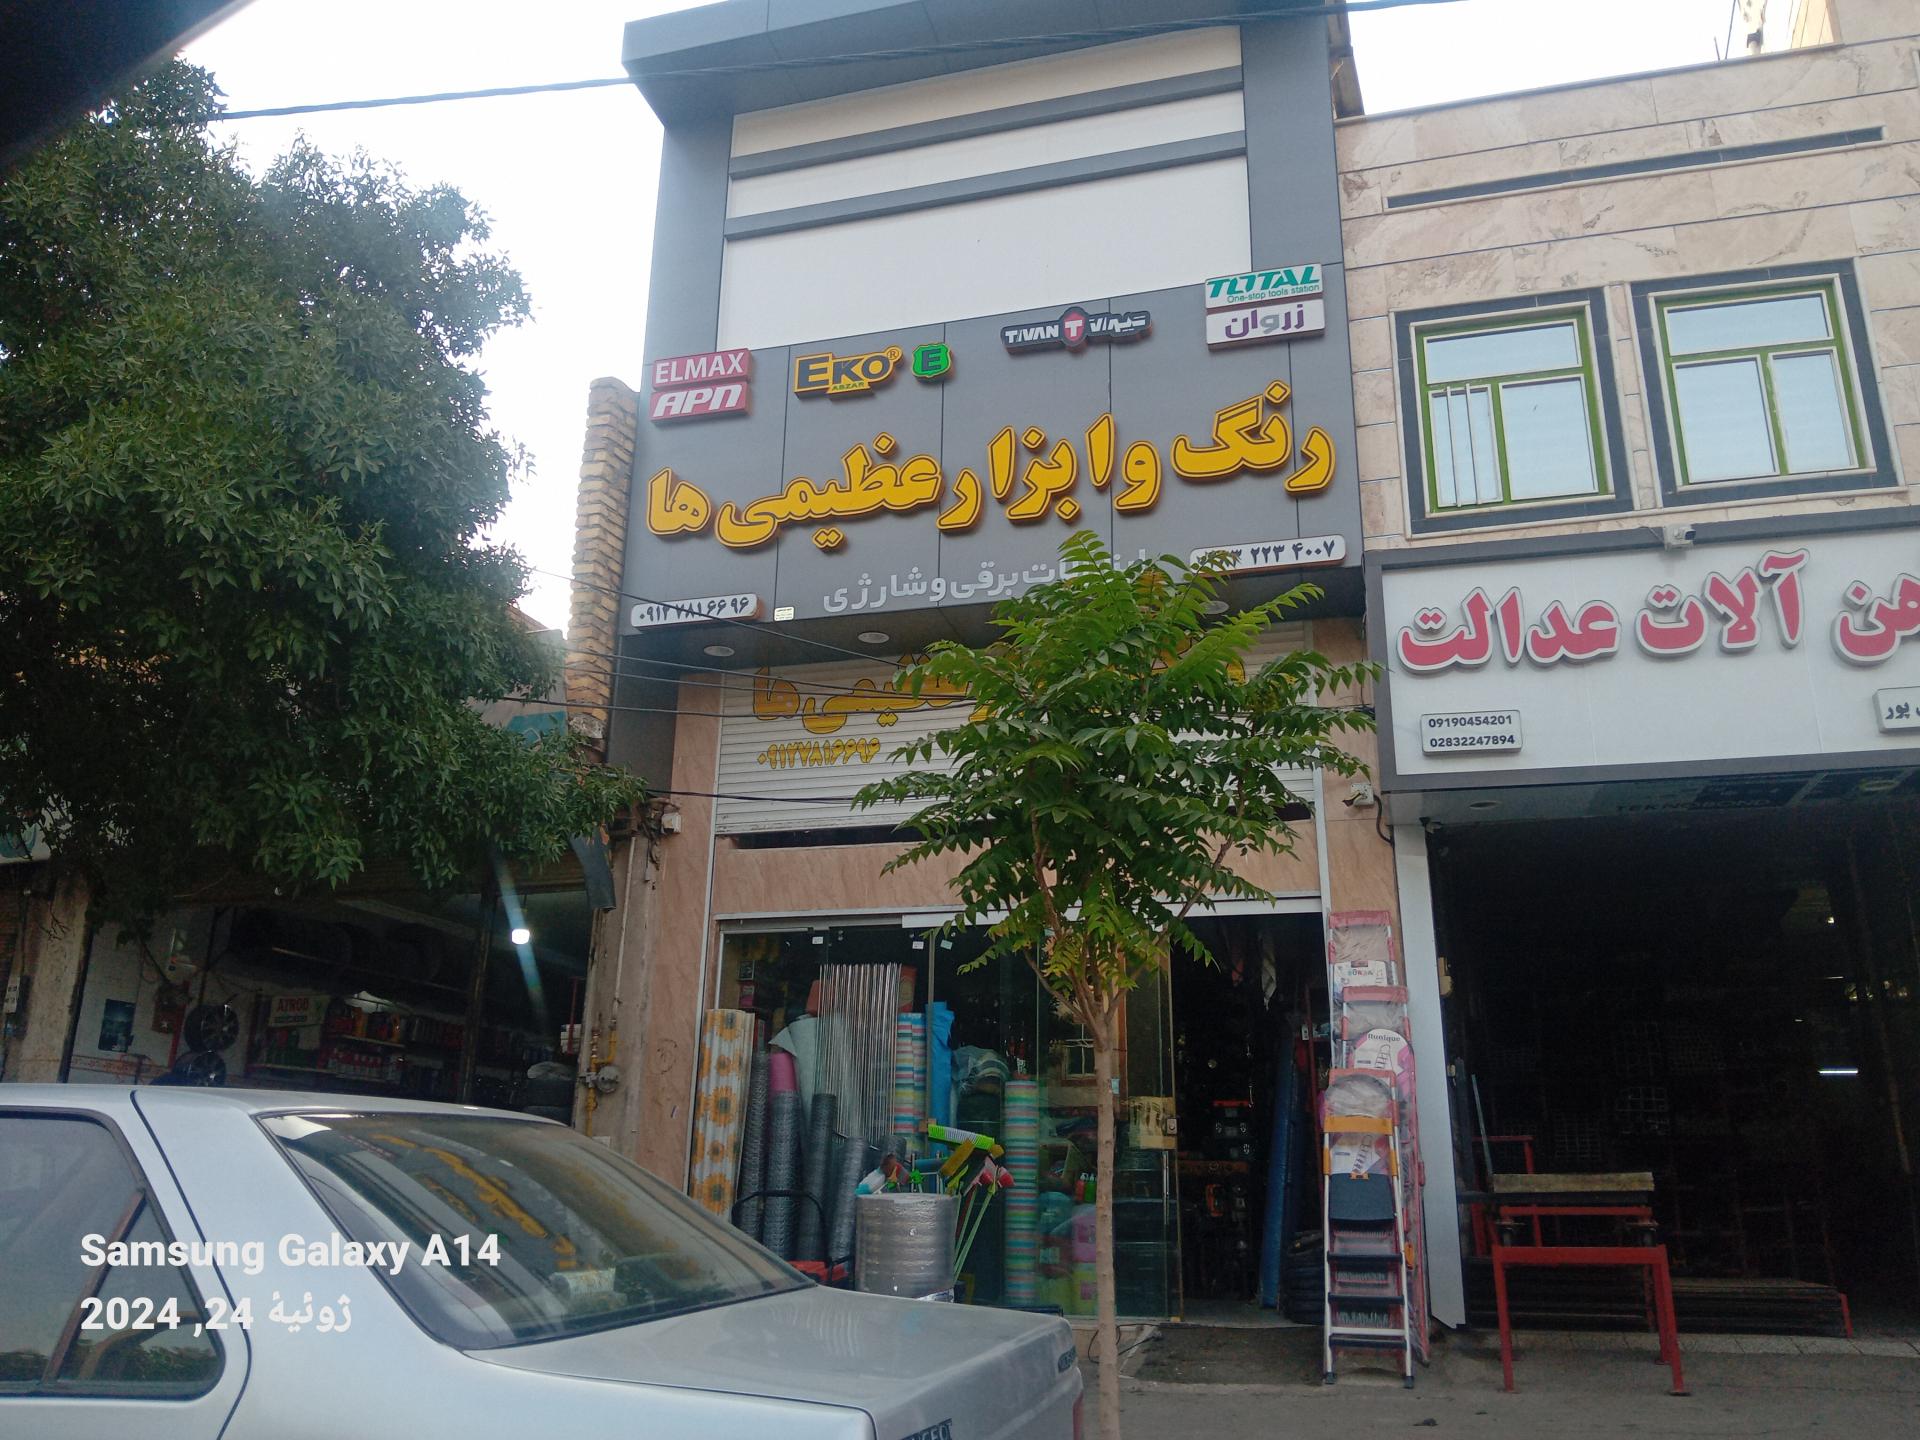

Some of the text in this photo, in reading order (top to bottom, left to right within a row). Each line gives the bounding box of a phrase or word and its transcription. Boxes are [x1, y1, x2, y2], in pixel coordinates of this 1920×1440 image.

[1207, 266, 1321, 298] TOTAL
[1227, 284, 1320, 303] One-stop tools station
[1005, 325, 1059, 343] TIVAN
[1225, 304, 1304, 338] زروان
[655, 352, 745, 384] ELMAX
[922, 349, 941, 372] E
[652, 384, 742, 417] APN
[832, 382, 865, 391] ABZAR
[1171, 379, 1336, 494] رنگ
[937, 412, 1114, 531] ابزار
[1114, 440, 1161, 512] و
[823, 566, 928, 613] شارژی
[929, 577, 947, 602] و
[950, 561, 1019, 599] برقی
[1636, 548, 1810, 656] آلات
[1397, 587, 1622, 672] عدالت
[1428, 715, 1512, 728] 09190454201
[1430, 735, 1515, 748] 02832247894
